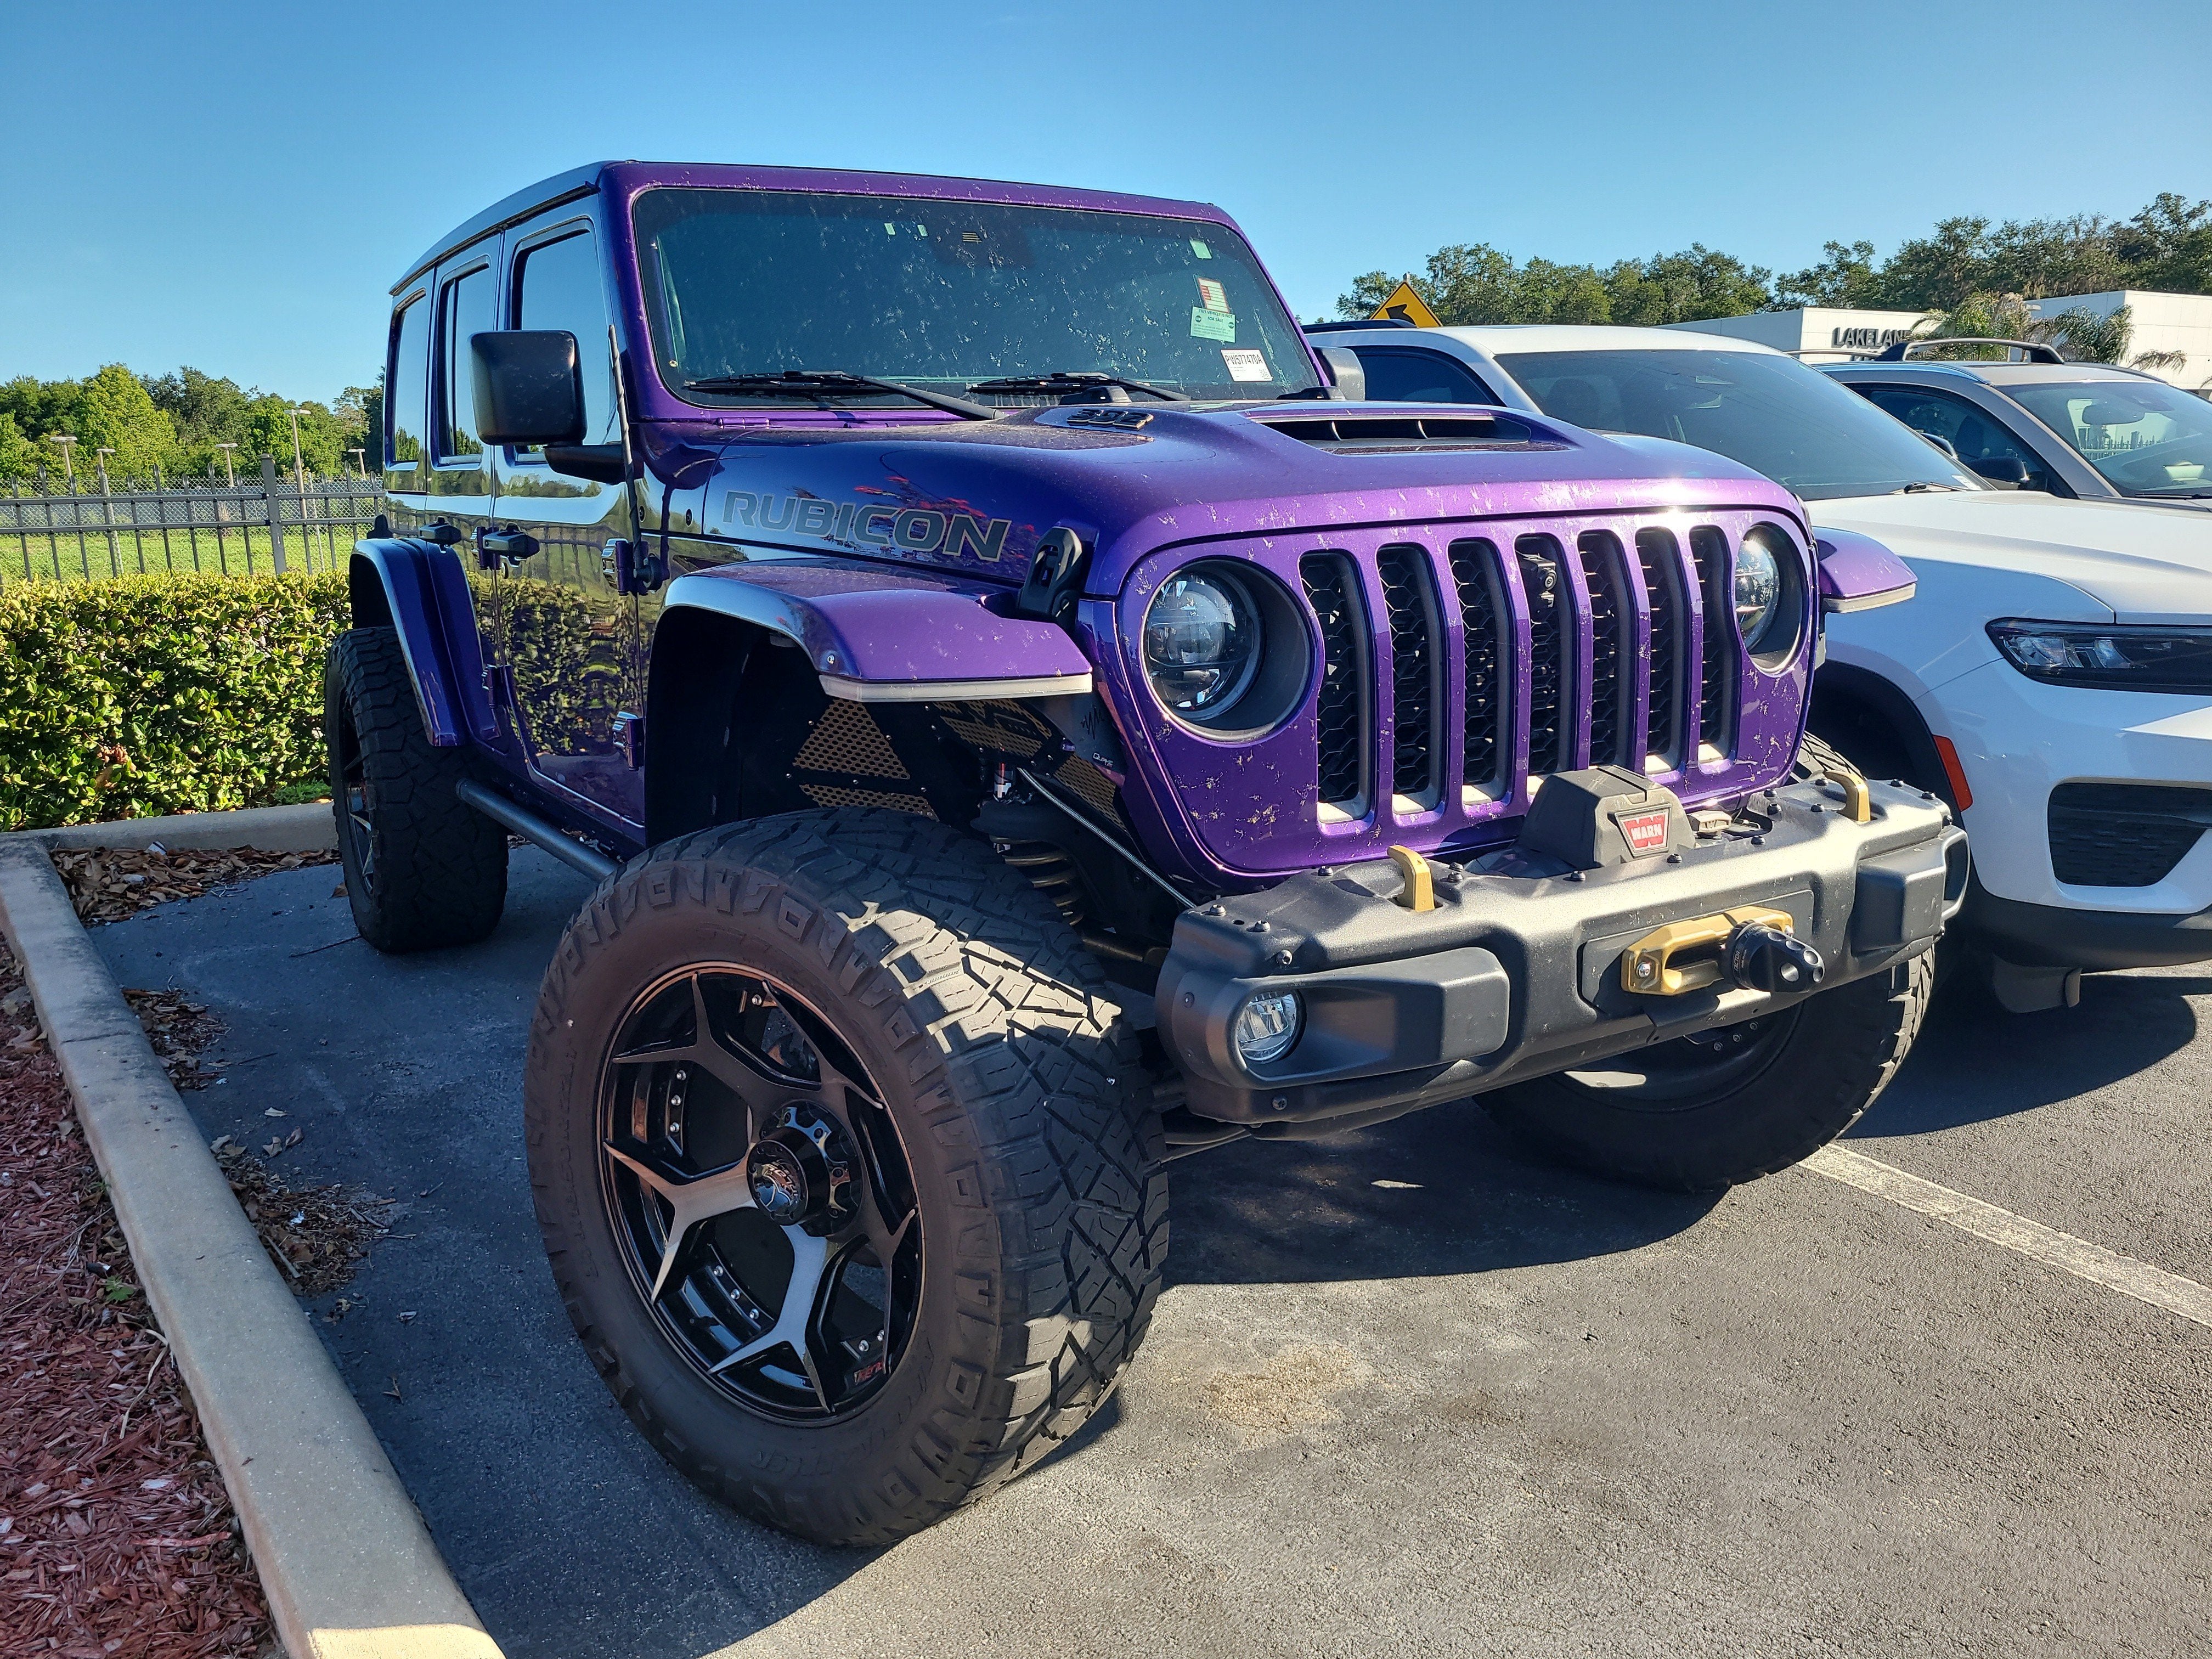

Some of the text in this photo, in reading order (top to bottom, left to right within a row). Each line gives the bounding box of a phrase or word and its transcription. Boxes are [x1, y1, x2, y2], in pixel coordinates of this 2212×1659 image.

[1224, 354, 1263, 365] PW577470A
[722, 490, 1012, 563] RUBICON
[1630, 823, 1663, 840] WARN
